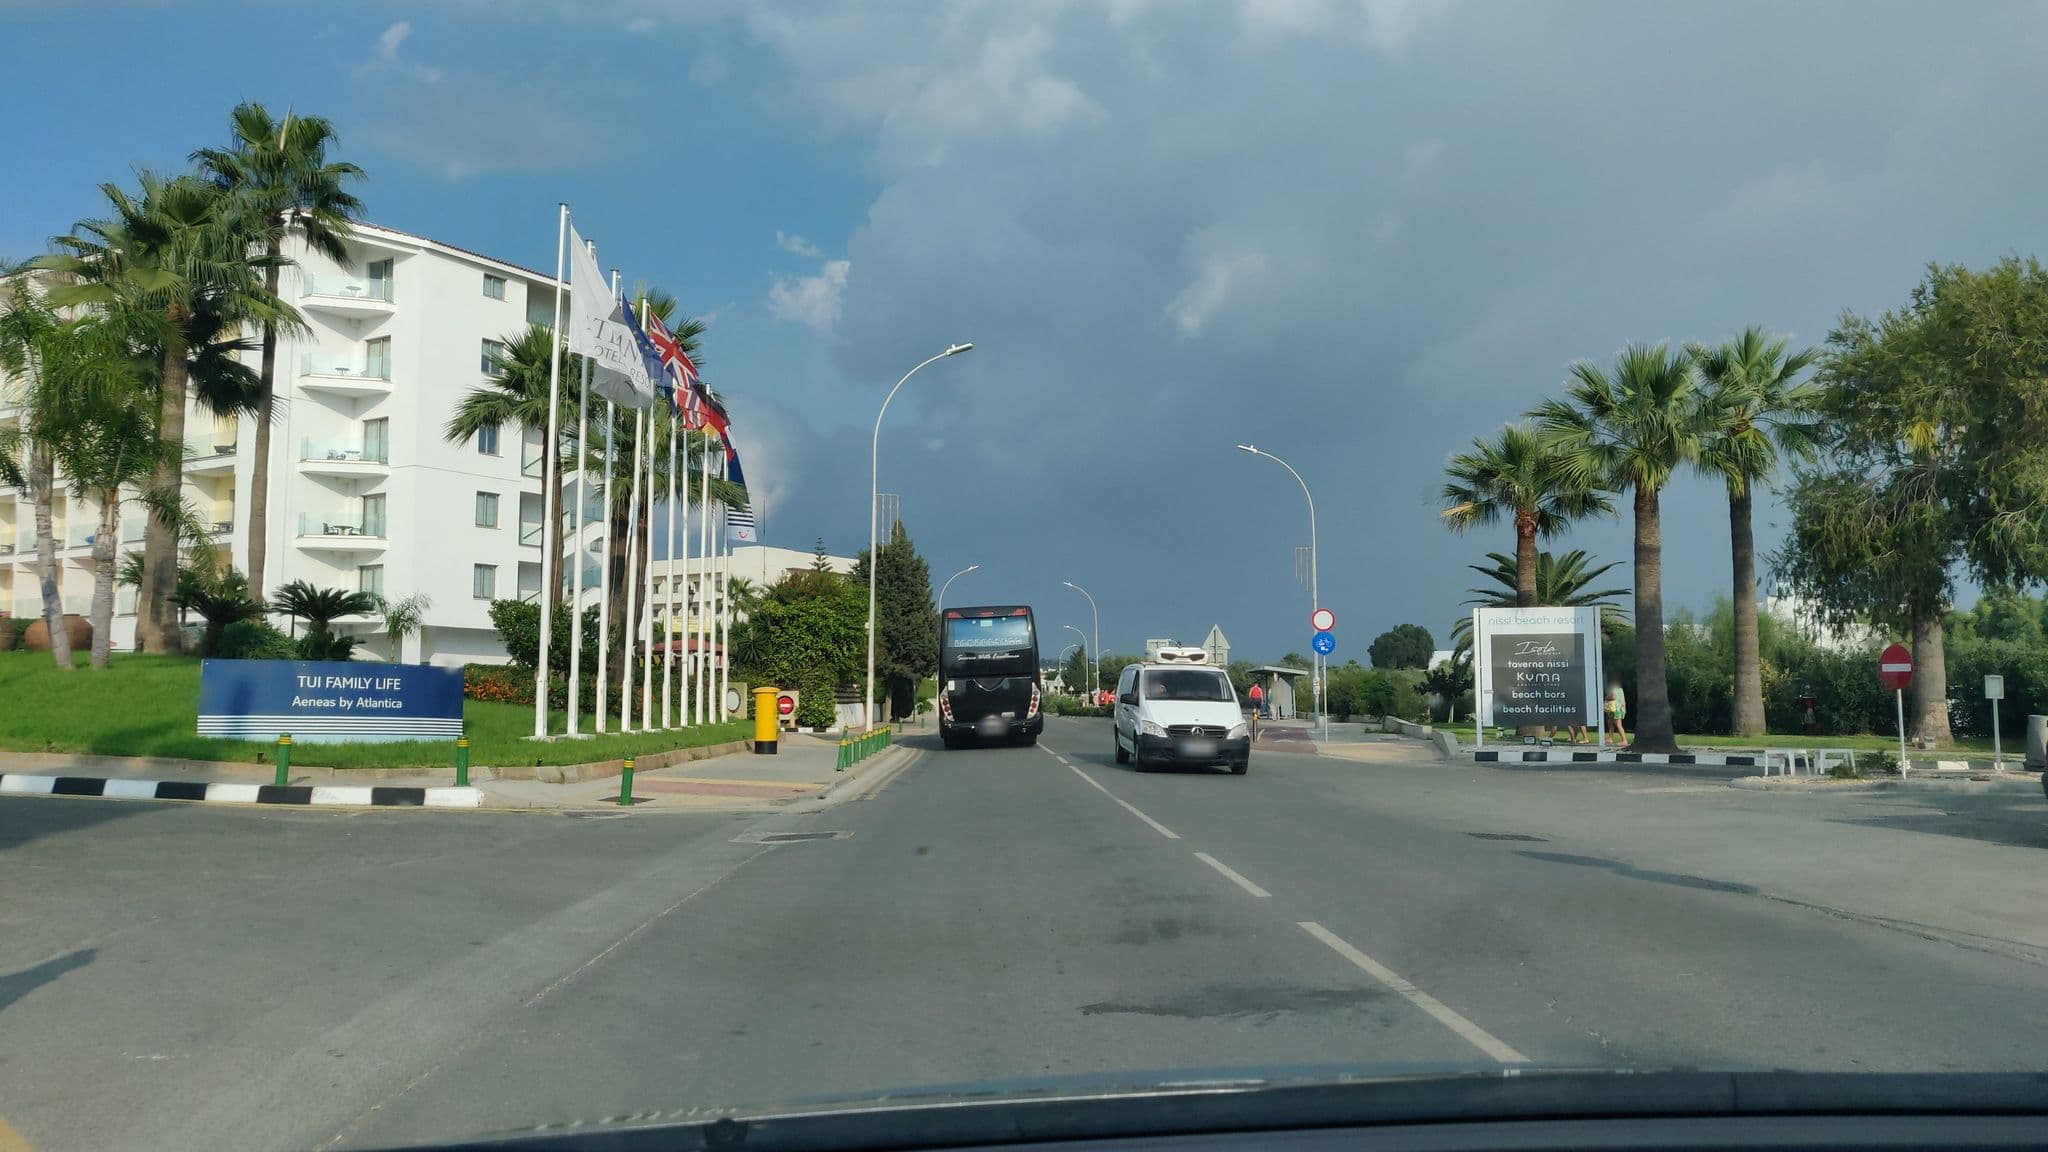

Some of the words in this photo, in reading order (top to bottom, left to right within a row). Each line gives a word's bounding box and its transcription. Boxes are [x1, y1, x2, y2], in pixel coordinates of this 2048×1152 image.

[1488, 615, 1512, 625] nissi
[1515, 615, 1550, 625] beach
[1553, 615, 1584, 625] resort
[1507, 660, 1544, 668] taverna
[1546, 659, 1569, 668] nissi
[297, 675, 321, 689] TUI
[325, 676, 373, 690] FAMILY
[375, 677, 401, 691] LIFE
[1511, 689, 1542, 699] beach
[1544, 689, 1566, 699] bars
[292, 695, 336, 708] Aeneas
[339, 696, 354, 711] by
[355, 696, 403, 709] Atlantica
[1502, 704, 1532, 713] beach
[1534, 704, 1577, 713] facilities
